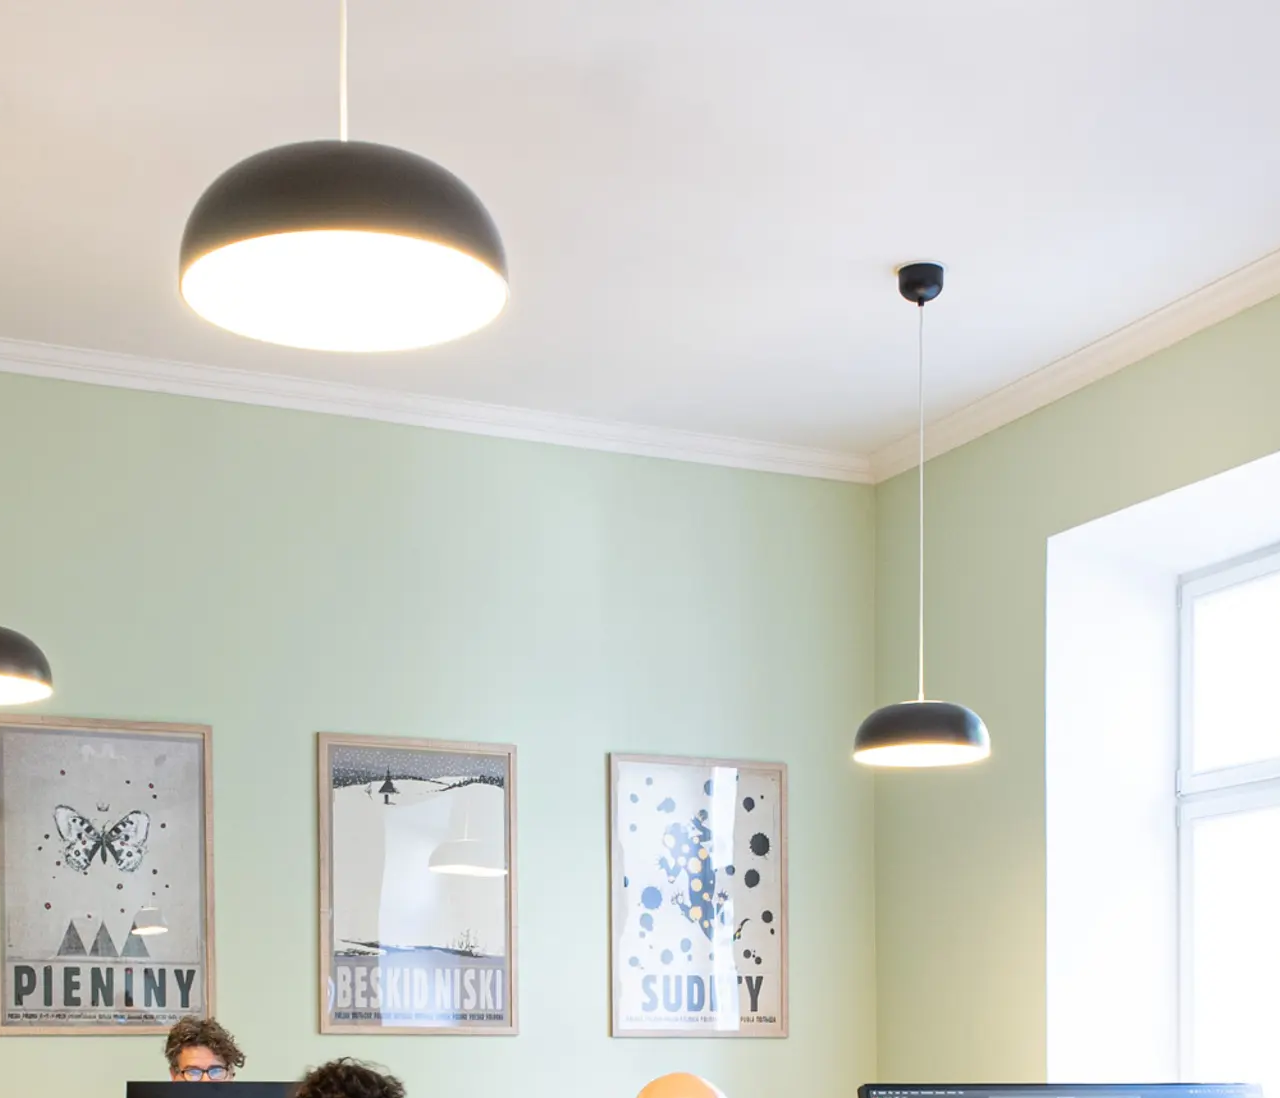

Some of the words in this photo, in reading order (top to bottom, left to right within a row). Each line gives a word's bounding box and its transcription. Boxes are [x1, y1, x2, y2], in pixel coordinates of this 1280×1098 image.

[14, 965, 196, 1008] PIENINY
[336, 965, 428, 1010] BESKID
[434, 967, 503, 1011] NISKI
[641, 974, 764, 1012] SUDY
